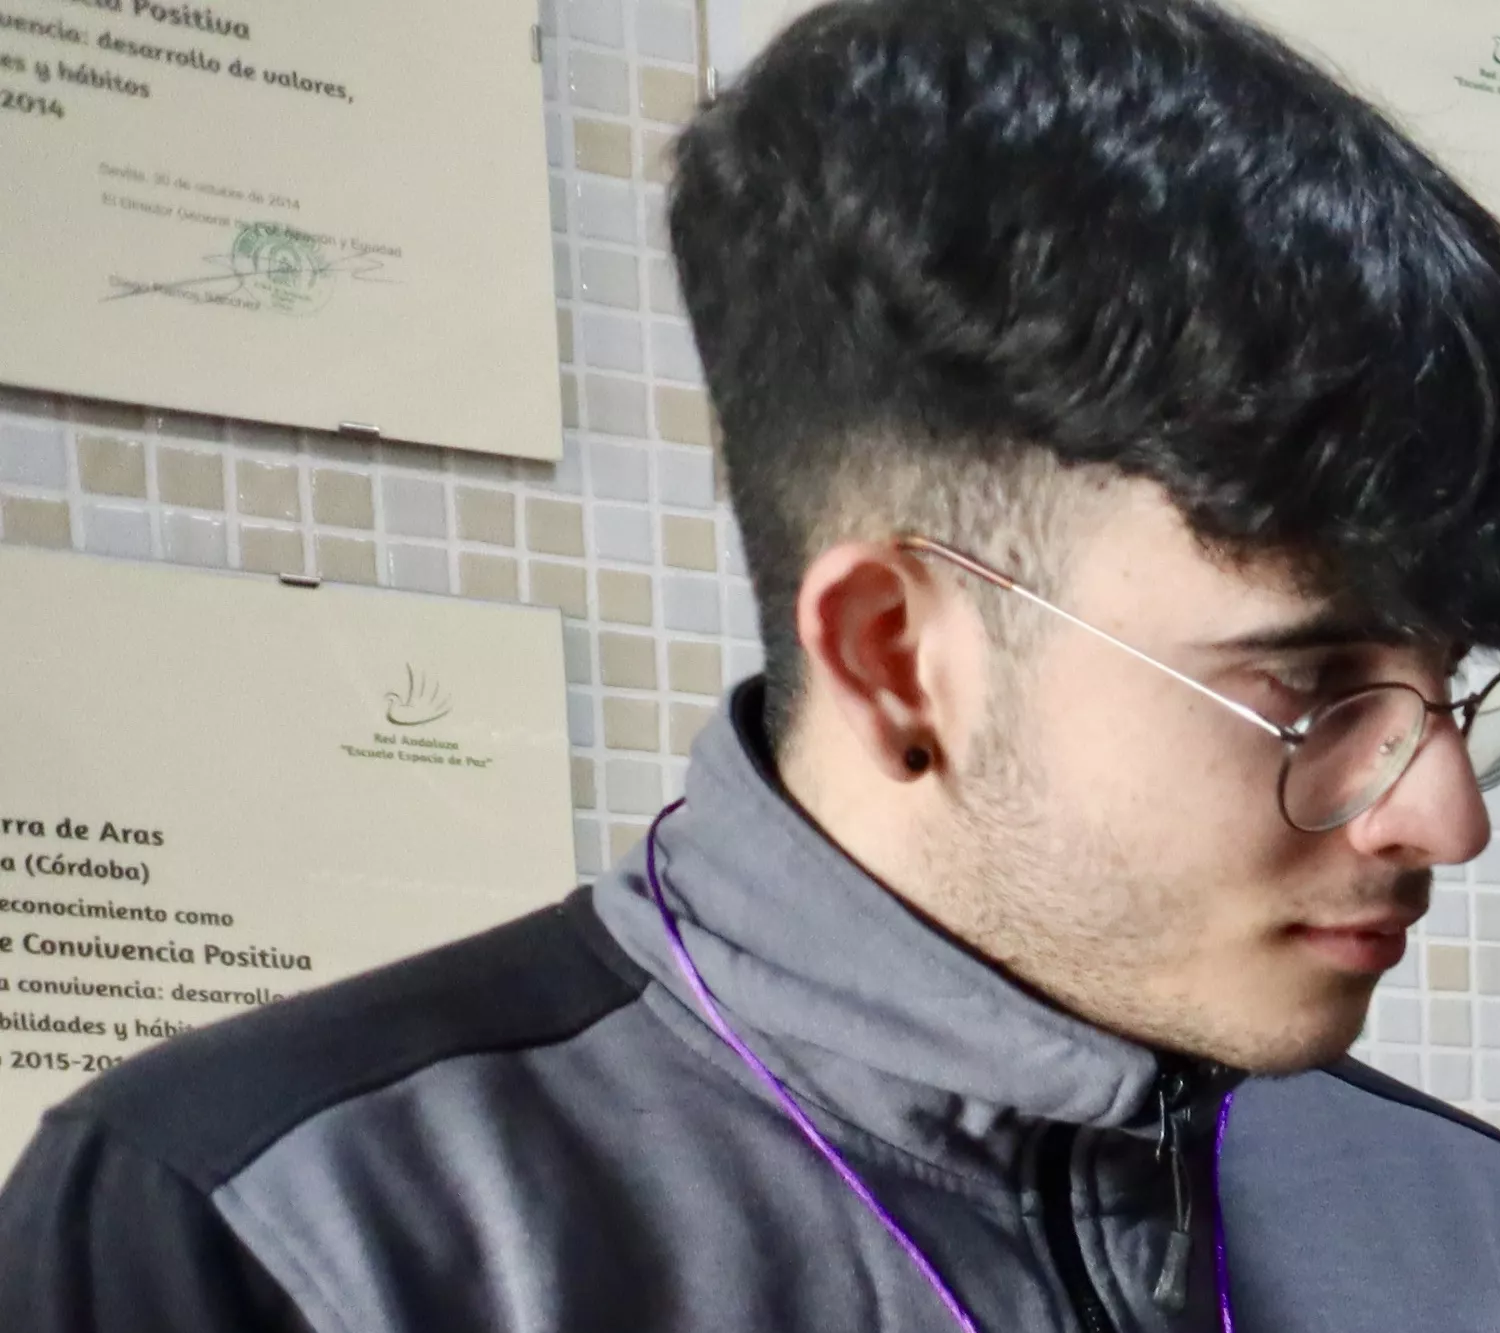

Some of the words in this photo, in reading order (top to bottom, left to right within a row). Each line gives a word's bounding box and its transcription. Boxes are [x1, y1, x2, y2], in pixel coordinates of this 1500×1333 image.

[57, 59, 151, 98] hábitos
[96, 30, 221, 73] desarrollo
[228, 60, 256, 81] de
[263, 69, 354, 104] valores,
[55, 817, 89, 841] de
[99, 820, 165, 847] Aras
[24, 853, 151, 886] (Córdoba)
[175, 910, 234, 928] como
[23, 932, 195, 964] Convivencia
[204, 943, 313, 971] Positiva
[17, 977, 164, 1001] convivencia:
[114, 1021, 128, 1041] y
